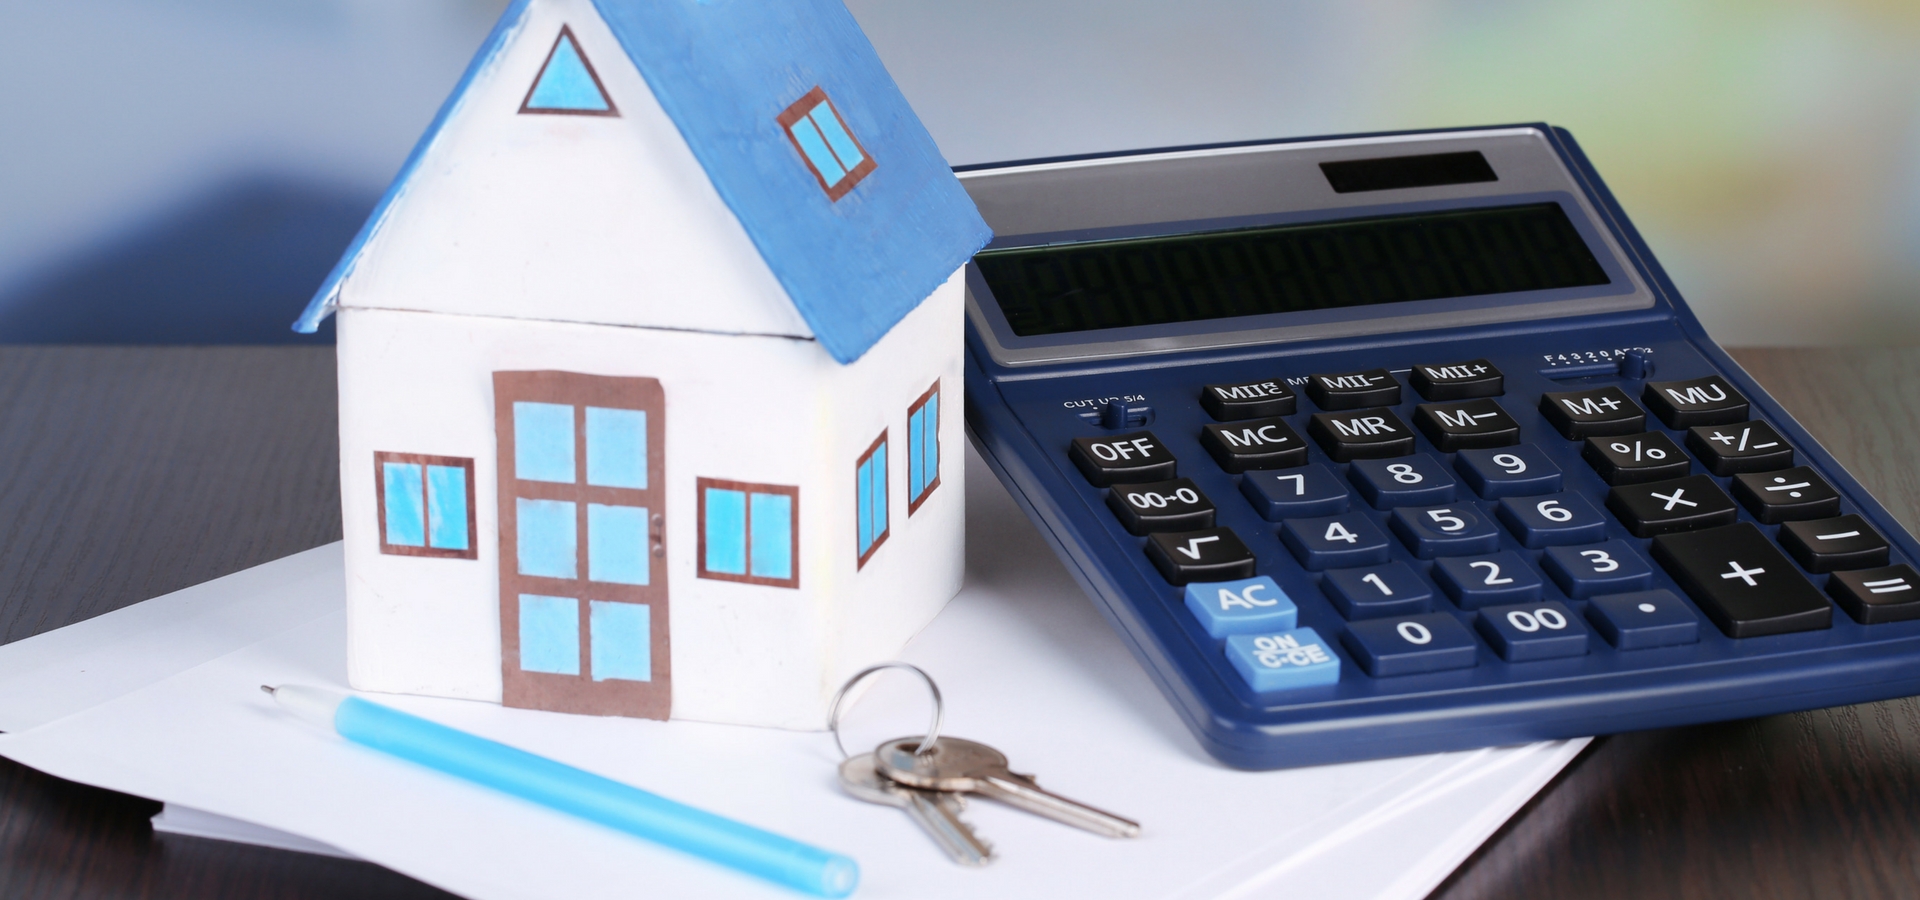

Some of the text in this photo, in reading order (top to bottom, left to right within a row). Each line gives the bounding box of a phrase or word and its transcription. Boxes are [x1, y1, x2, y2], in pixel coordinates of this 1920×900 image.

[1063, 399, 1094, 409] CUT
[1561, 396, 1621, 415] M+
[1665, 383, 1727, 405] MU
[1220, 425, 1288, 447] MC
[1330, 416, 1397, 437] MR
[1090, 437, 1154, 461] OFF
[1386, 463, 1423, 484] 8
[1492, 453, 1527, 474] 9
[1276, 473, 1305, 496] 7
[1426, 508, 1465, 531] 5
[1536, 500, 1573, 522] 6
[1324, 521, 1358, 544] 4
[1580, 549, 1619, 573] 3
[1362, 573, 1393, 596] 1
[1469, 560, 1514, 586] 2
[1218, 584, 1278, 610] AC
[1506, 608, 1567, 633] 00
[1253, 633, 1300, 651] ON
[1396, 621, 1432, 645] 0
